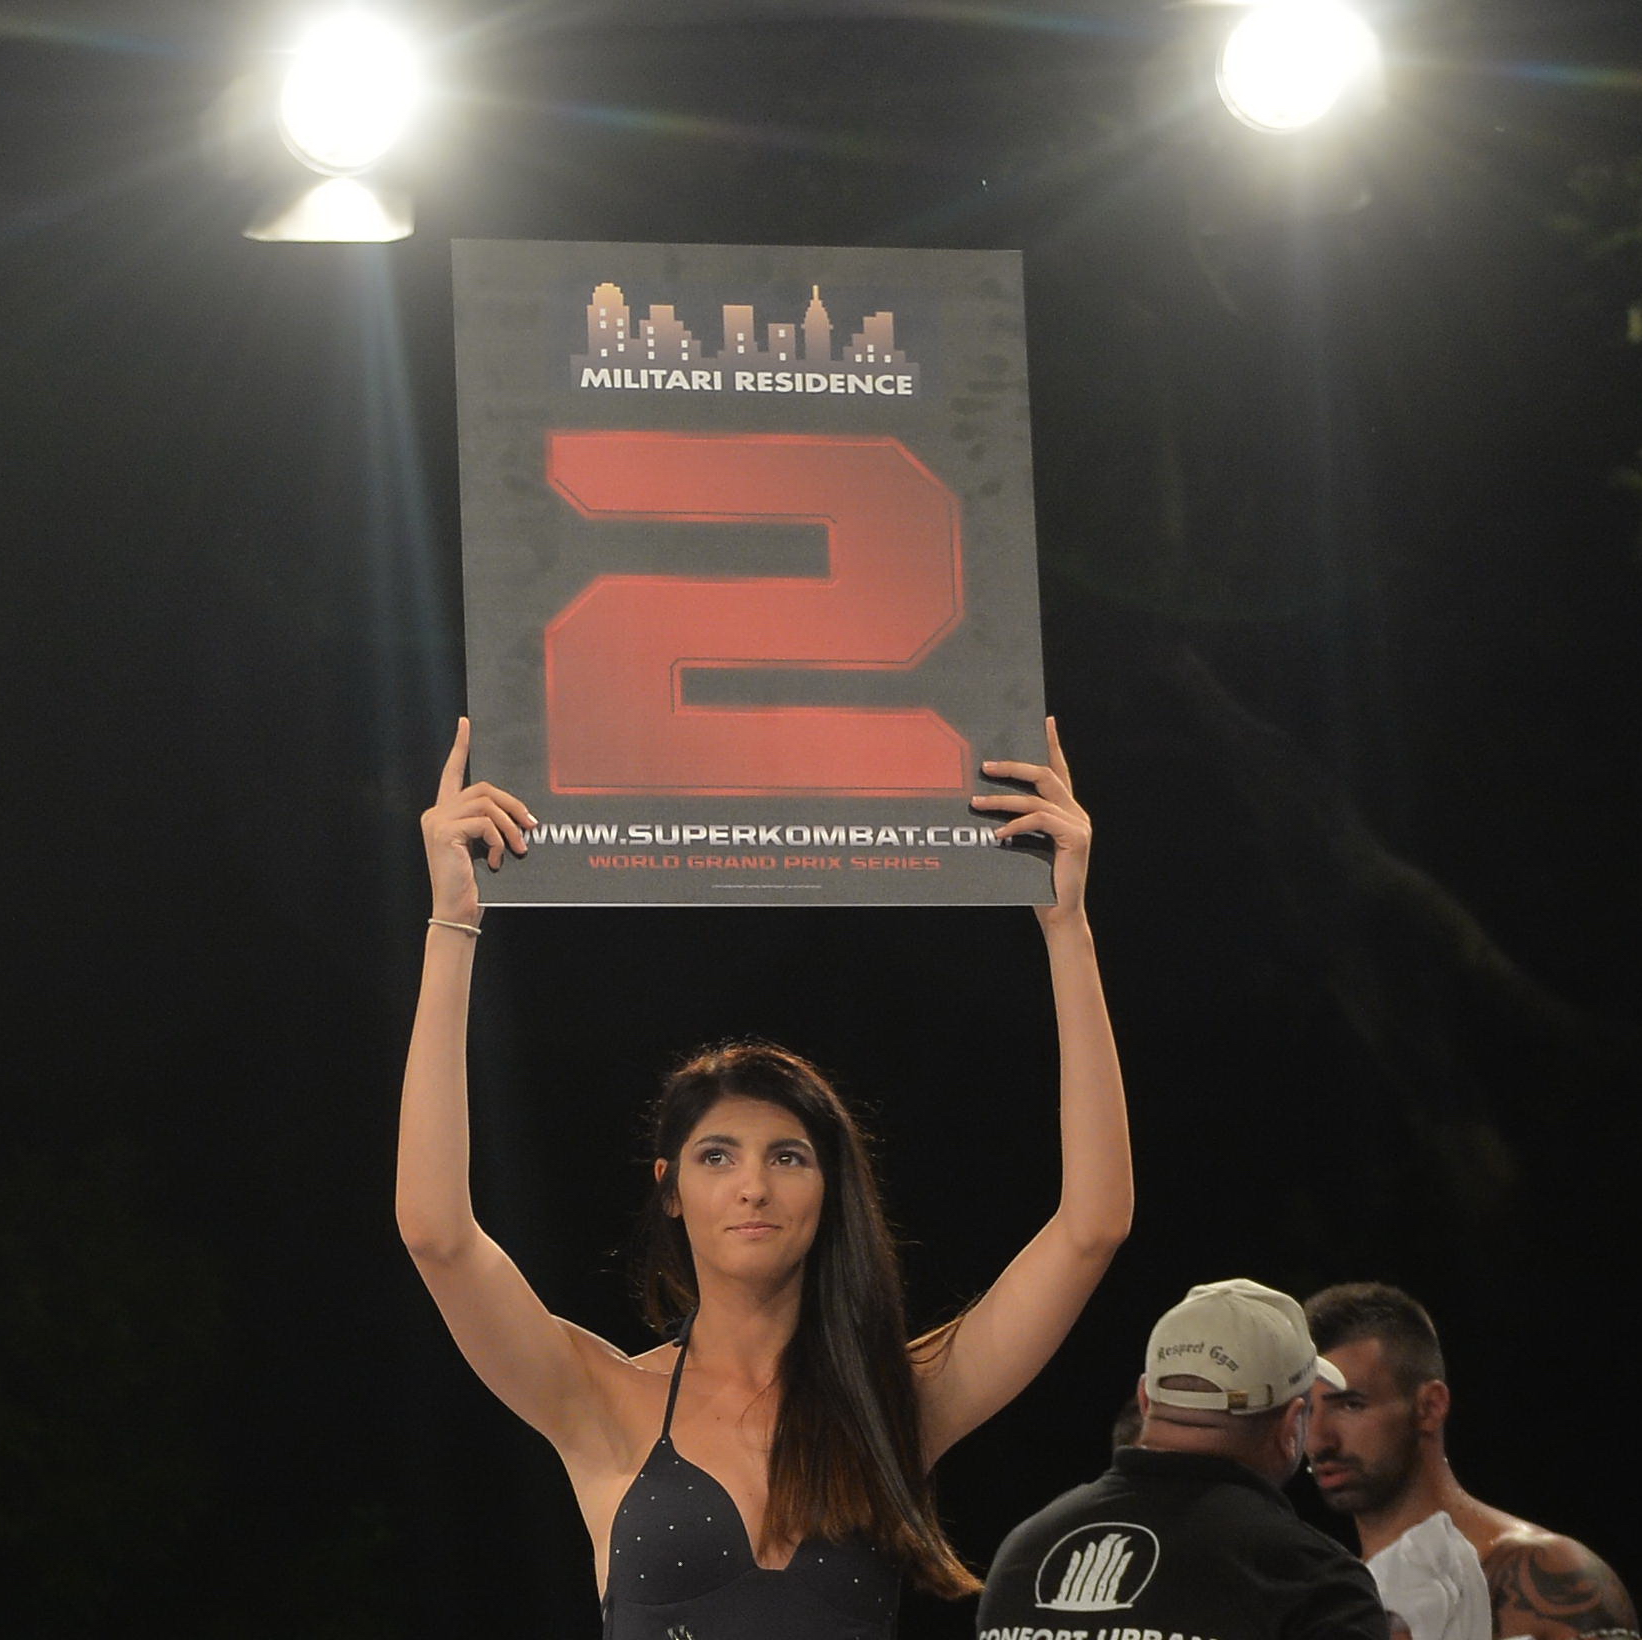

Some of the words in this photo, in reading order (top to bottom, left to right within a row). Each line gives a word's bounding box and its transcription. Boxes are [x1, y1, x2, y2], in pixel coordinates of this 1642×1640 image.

[580, 367, 723, 391] MILITARI
[734, 369, 913, 395] RESIDENCE
[547, 431, 969, 796] 2
[589, 855, 680, 869] WORLD
[687, 855, 776, 869] GRAND
[784, 855, 842, 870] PRIX
[850, 856, 942, 871] SERIES
